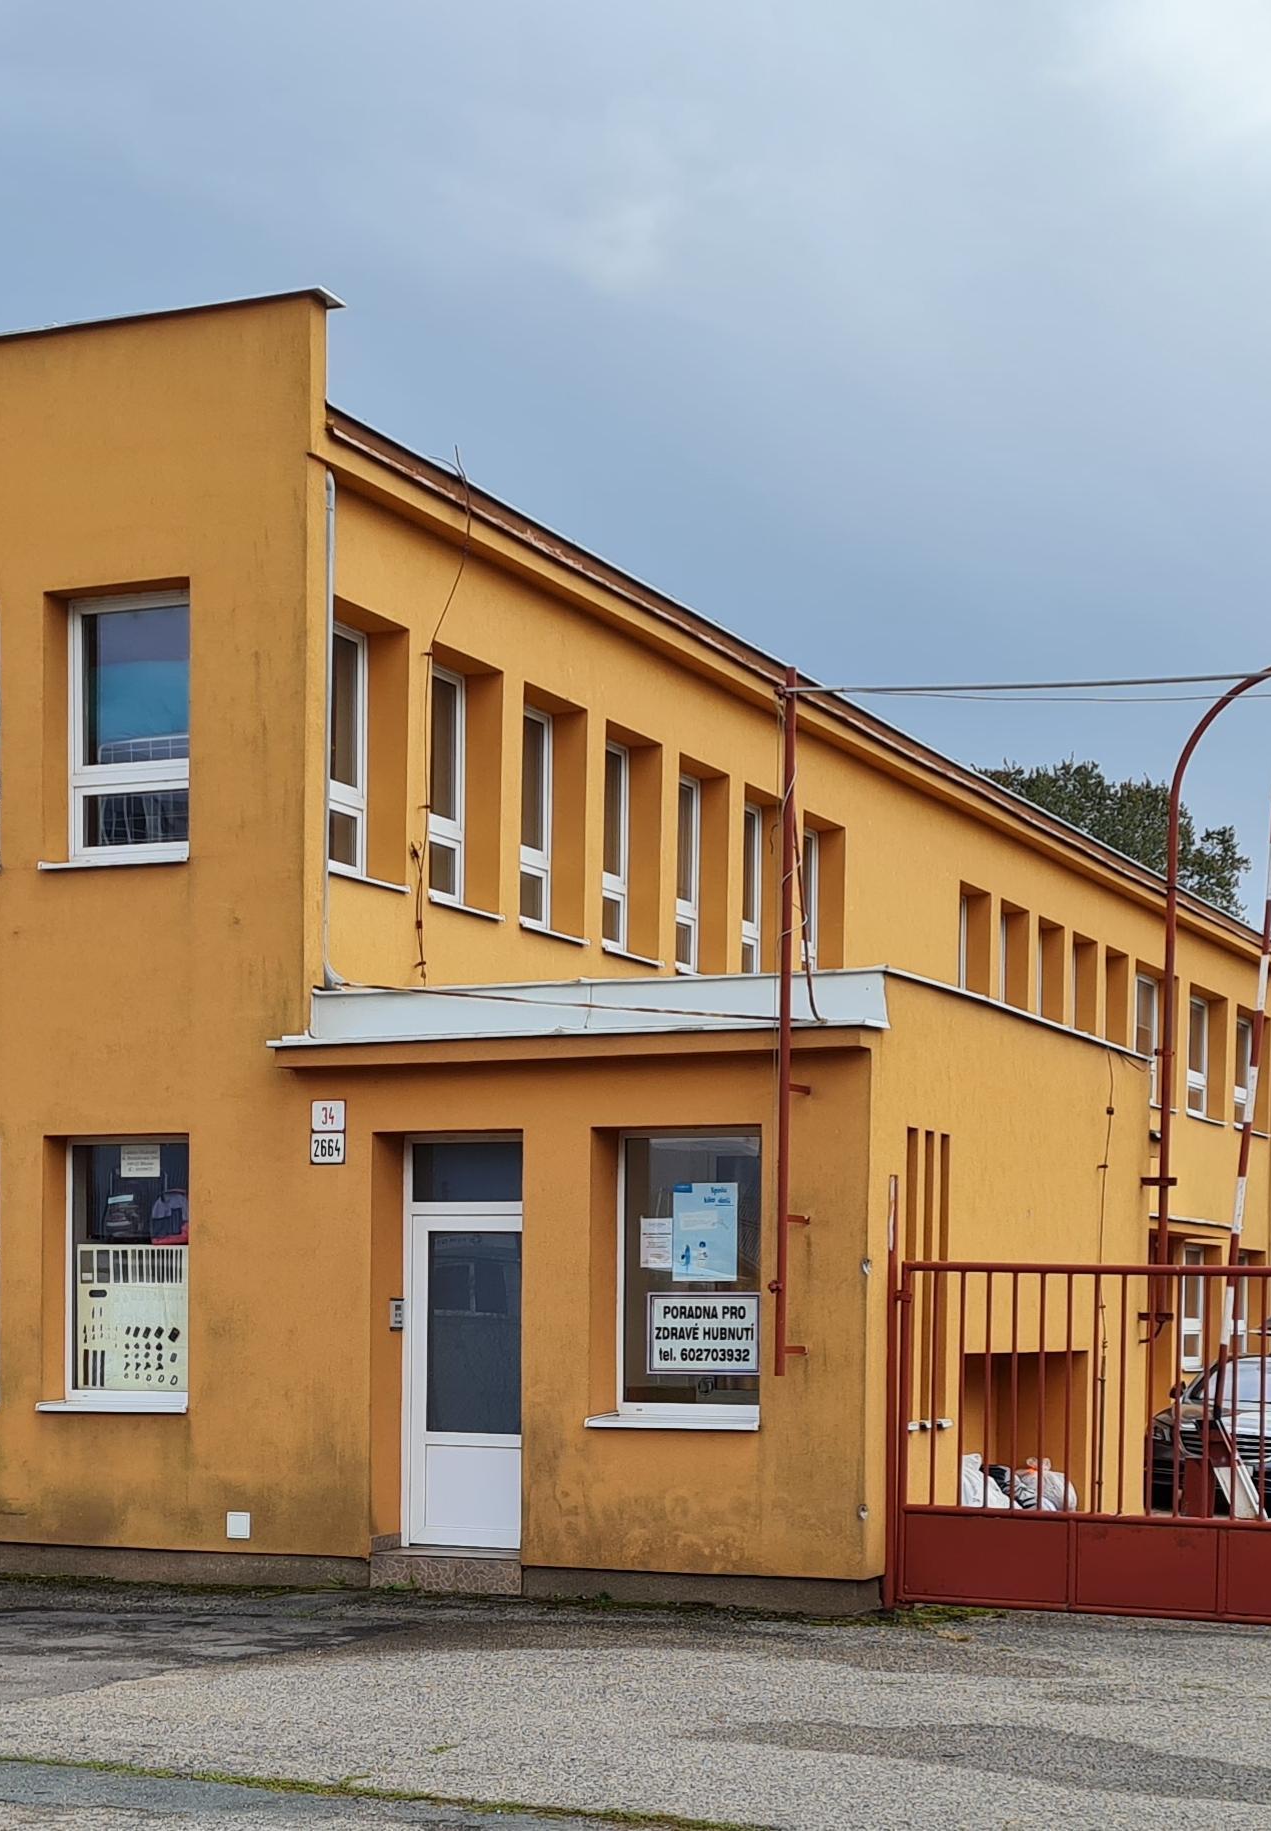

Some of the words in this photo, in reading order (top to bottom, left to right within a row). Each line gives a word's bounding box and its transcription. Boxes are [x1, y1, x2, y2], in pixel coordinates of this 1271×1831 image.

[321, 1106, 335, 1126] 34
[313, 1138, 341, 1158] 2664
[663, 1305, 718, 1320] PORADNA
[721, 1305, 746, 1320] PRO
[655, 1323, 699, 1341] ZDRAVÉ
[703, 1323, 754, 1341] HUBNUTÍ
[659, 1347, 676, 1361] tel.
[680, 1348, 750, 1362] 602703932
